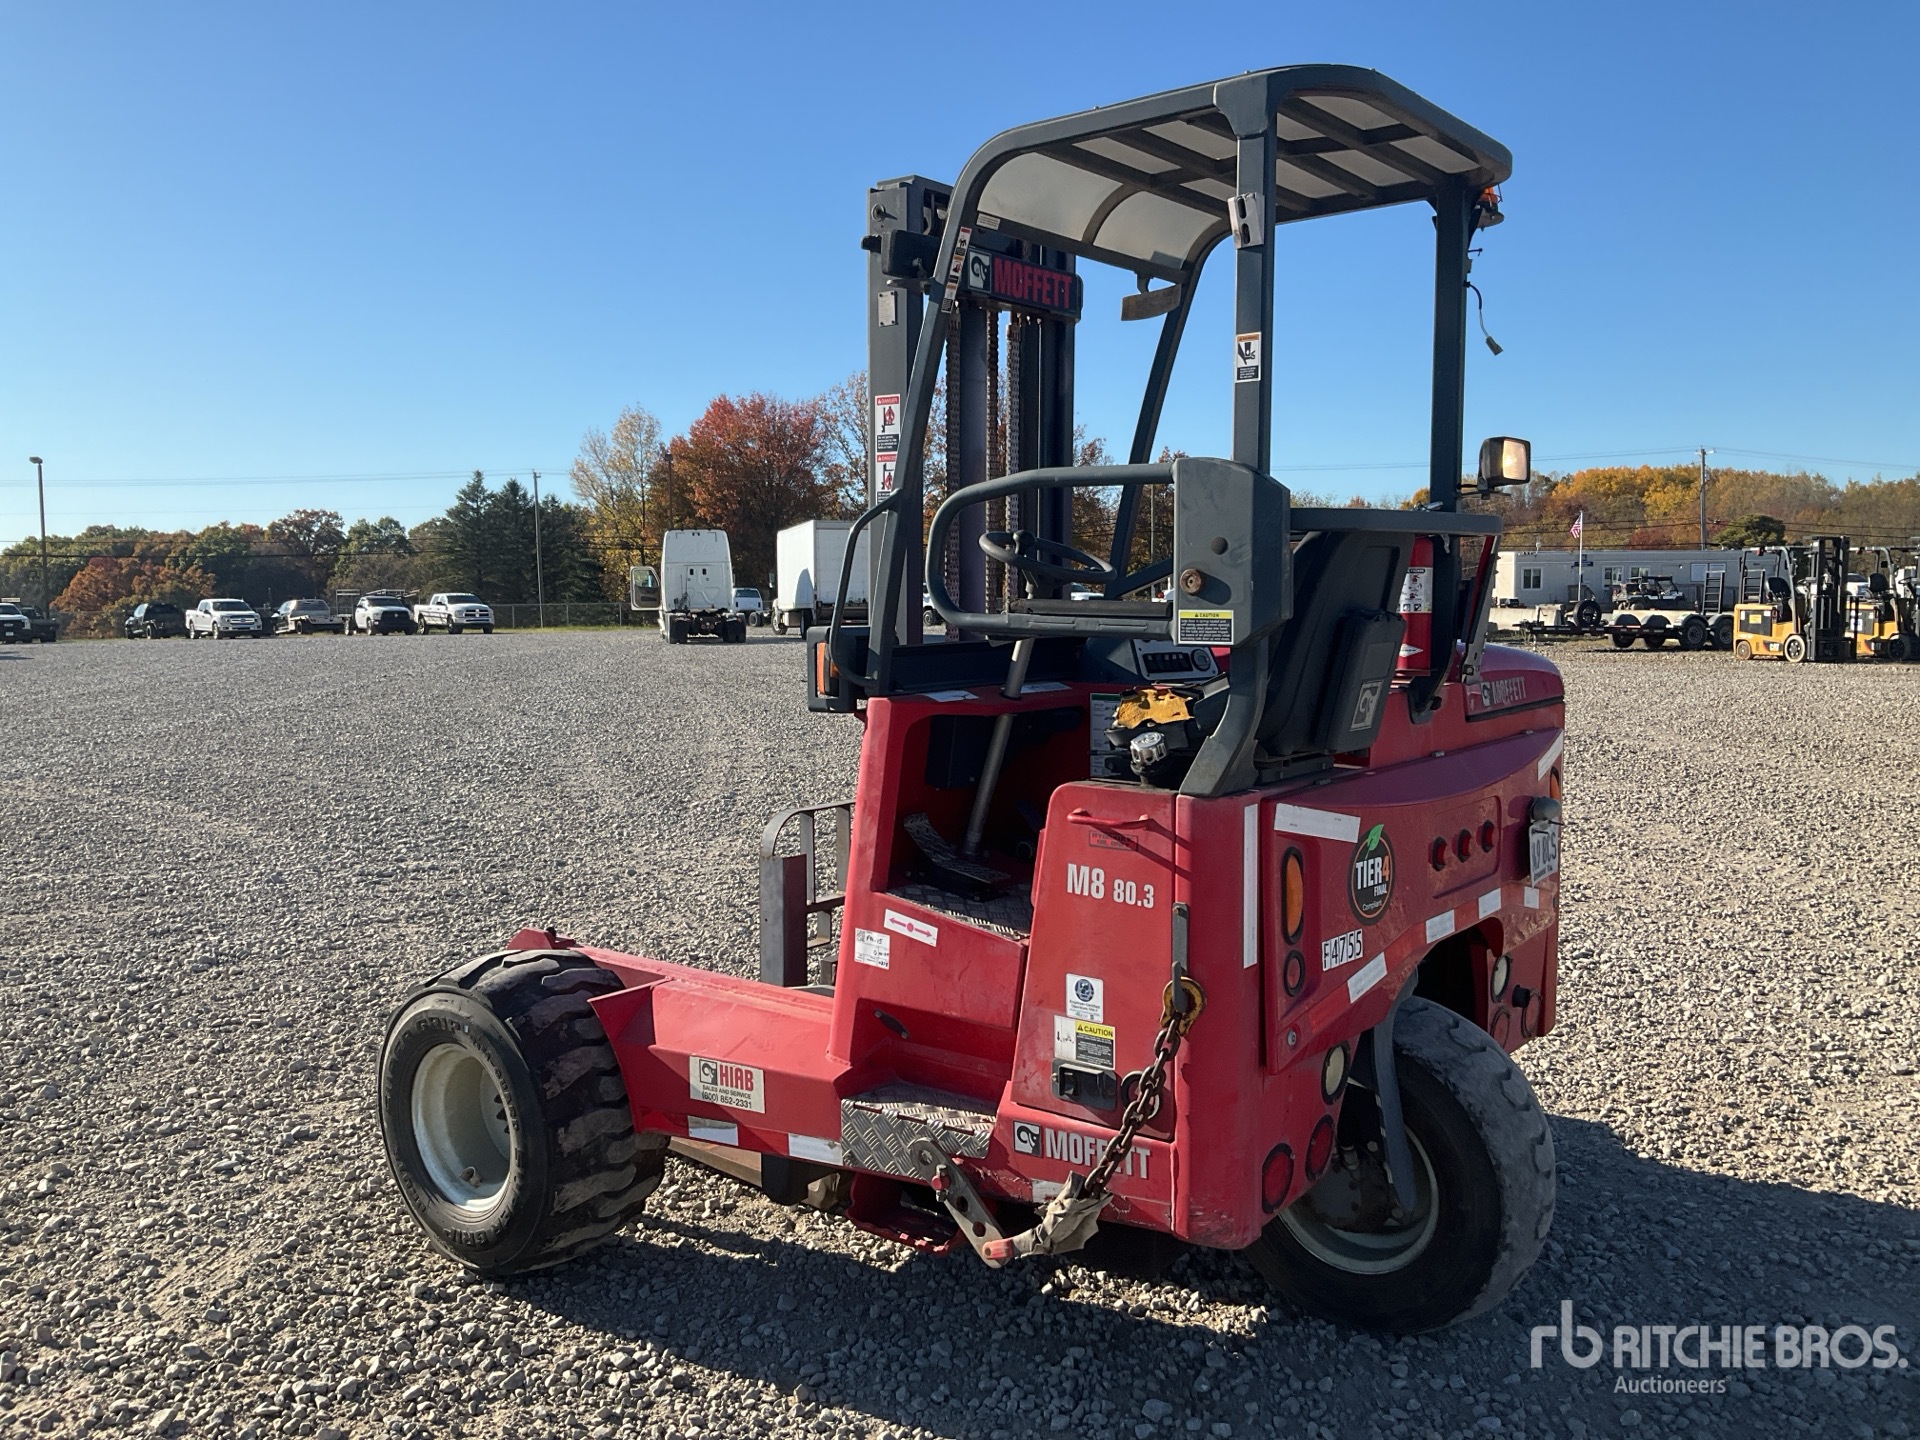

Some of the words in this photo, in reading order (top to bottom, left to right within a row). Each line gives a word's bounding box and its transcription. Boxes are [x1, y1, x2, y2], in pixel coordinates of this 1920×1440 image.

[993, 256, 1073, 309] MOFFETT
[1491, 676, 1526, 704] MOFFETT
[1067, 863, 1105, 899] M8
[1113, 878, 1154, 909] 80.3
[1373, 883, 1388, 897] FINAL
[1323, 929, 1362, 969] F4755
[1084, 1025, 1113, 1037] CAUTION
[702, 1084, 718, 1093] SALES
[730, 1090, 752, 1100] SERVICE
[719, 1064, 754, 1092] HIAB
[702, 1090, 719, 1101] (800)
[720, 1095, 752, 1109] 852-2331
[1045, 1128, 1152, 1179] MOFFTT
